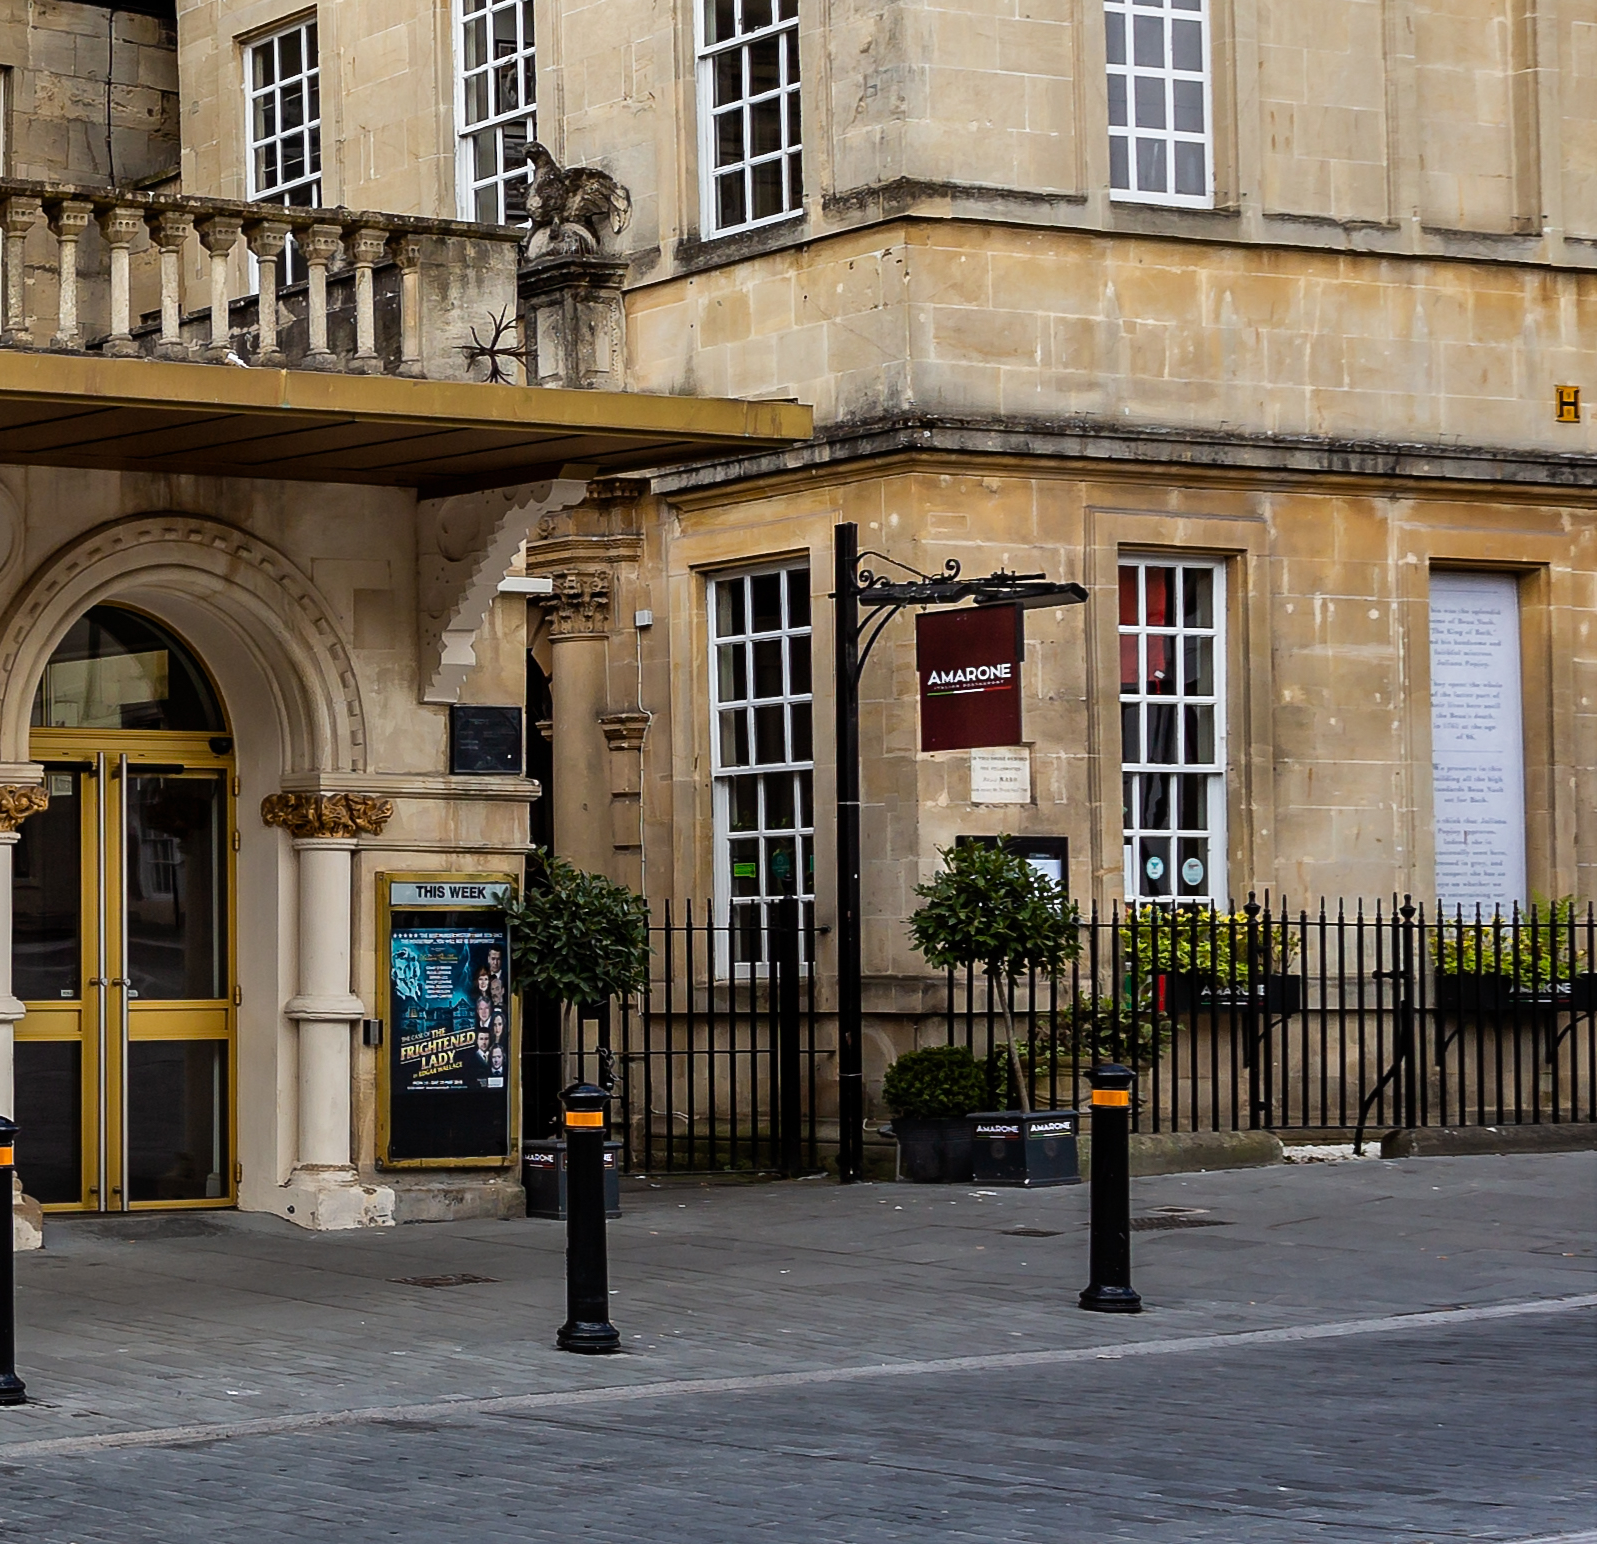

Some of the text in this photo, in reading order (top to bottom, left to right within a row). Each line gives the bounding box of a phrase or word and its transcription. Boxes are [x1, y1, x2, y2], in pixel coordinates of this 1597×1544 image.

[1557, 389, 1579, 419] H
[928, 663, 1011, 685] AMARONE
[416, 886, 486, 899] THIS WEEK
[432, 1028, 446, 1038] THE
[400, 1031, 475, 1060] FRIGHTENED
[421, 1050, 455, 1070] LADY
[976, 1125, 1019, 1133] AMARONE
[1030, 1122, 1071, 1132] AMARONE
[525, 1154, 554, 1162] MARONE
